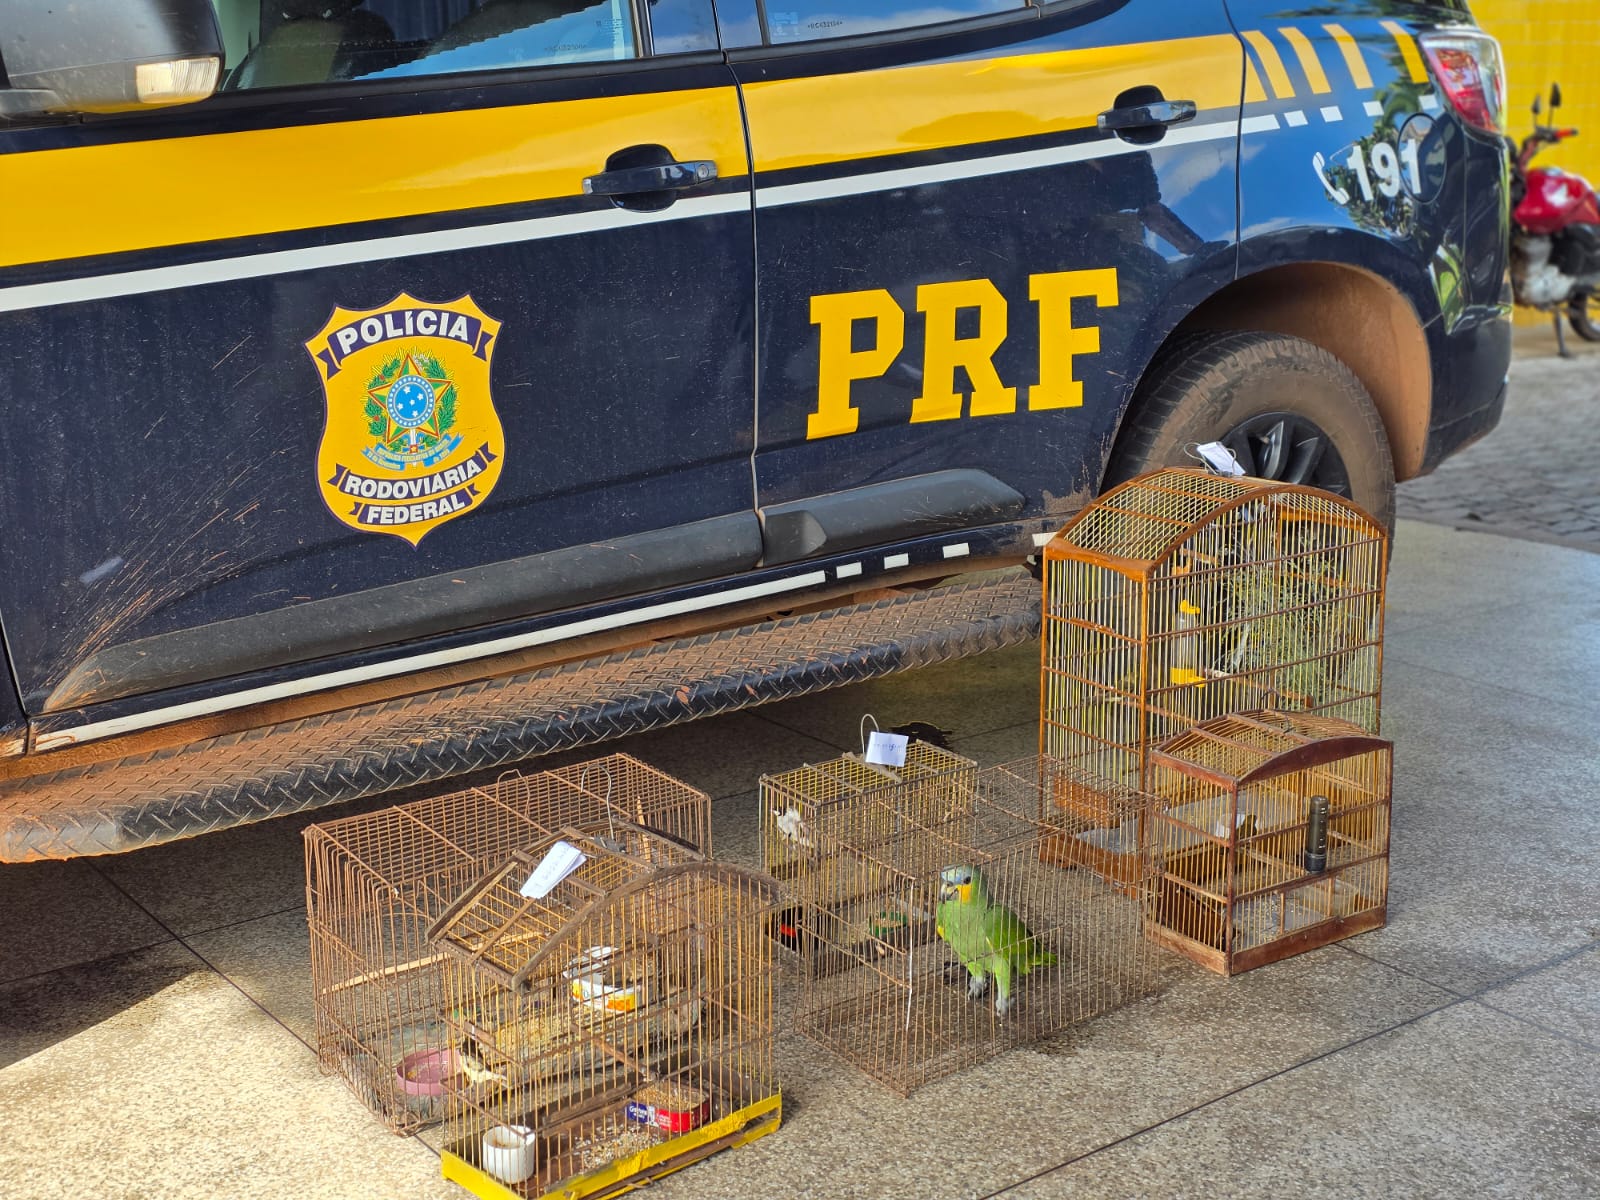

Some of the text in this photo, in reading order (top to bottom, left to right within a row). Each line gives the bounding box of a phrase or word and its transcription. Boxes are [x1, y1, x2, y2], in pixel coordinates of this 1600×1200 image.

[1347, 138, 1422, 201] 191
[336, 310, 468, 355] POLÍCIA
[806, 267, 1119, 440] PRF
[344, 459, 482, 499] RODOVIÁRIA
[366, 494, 465, 524] FEDERAL
